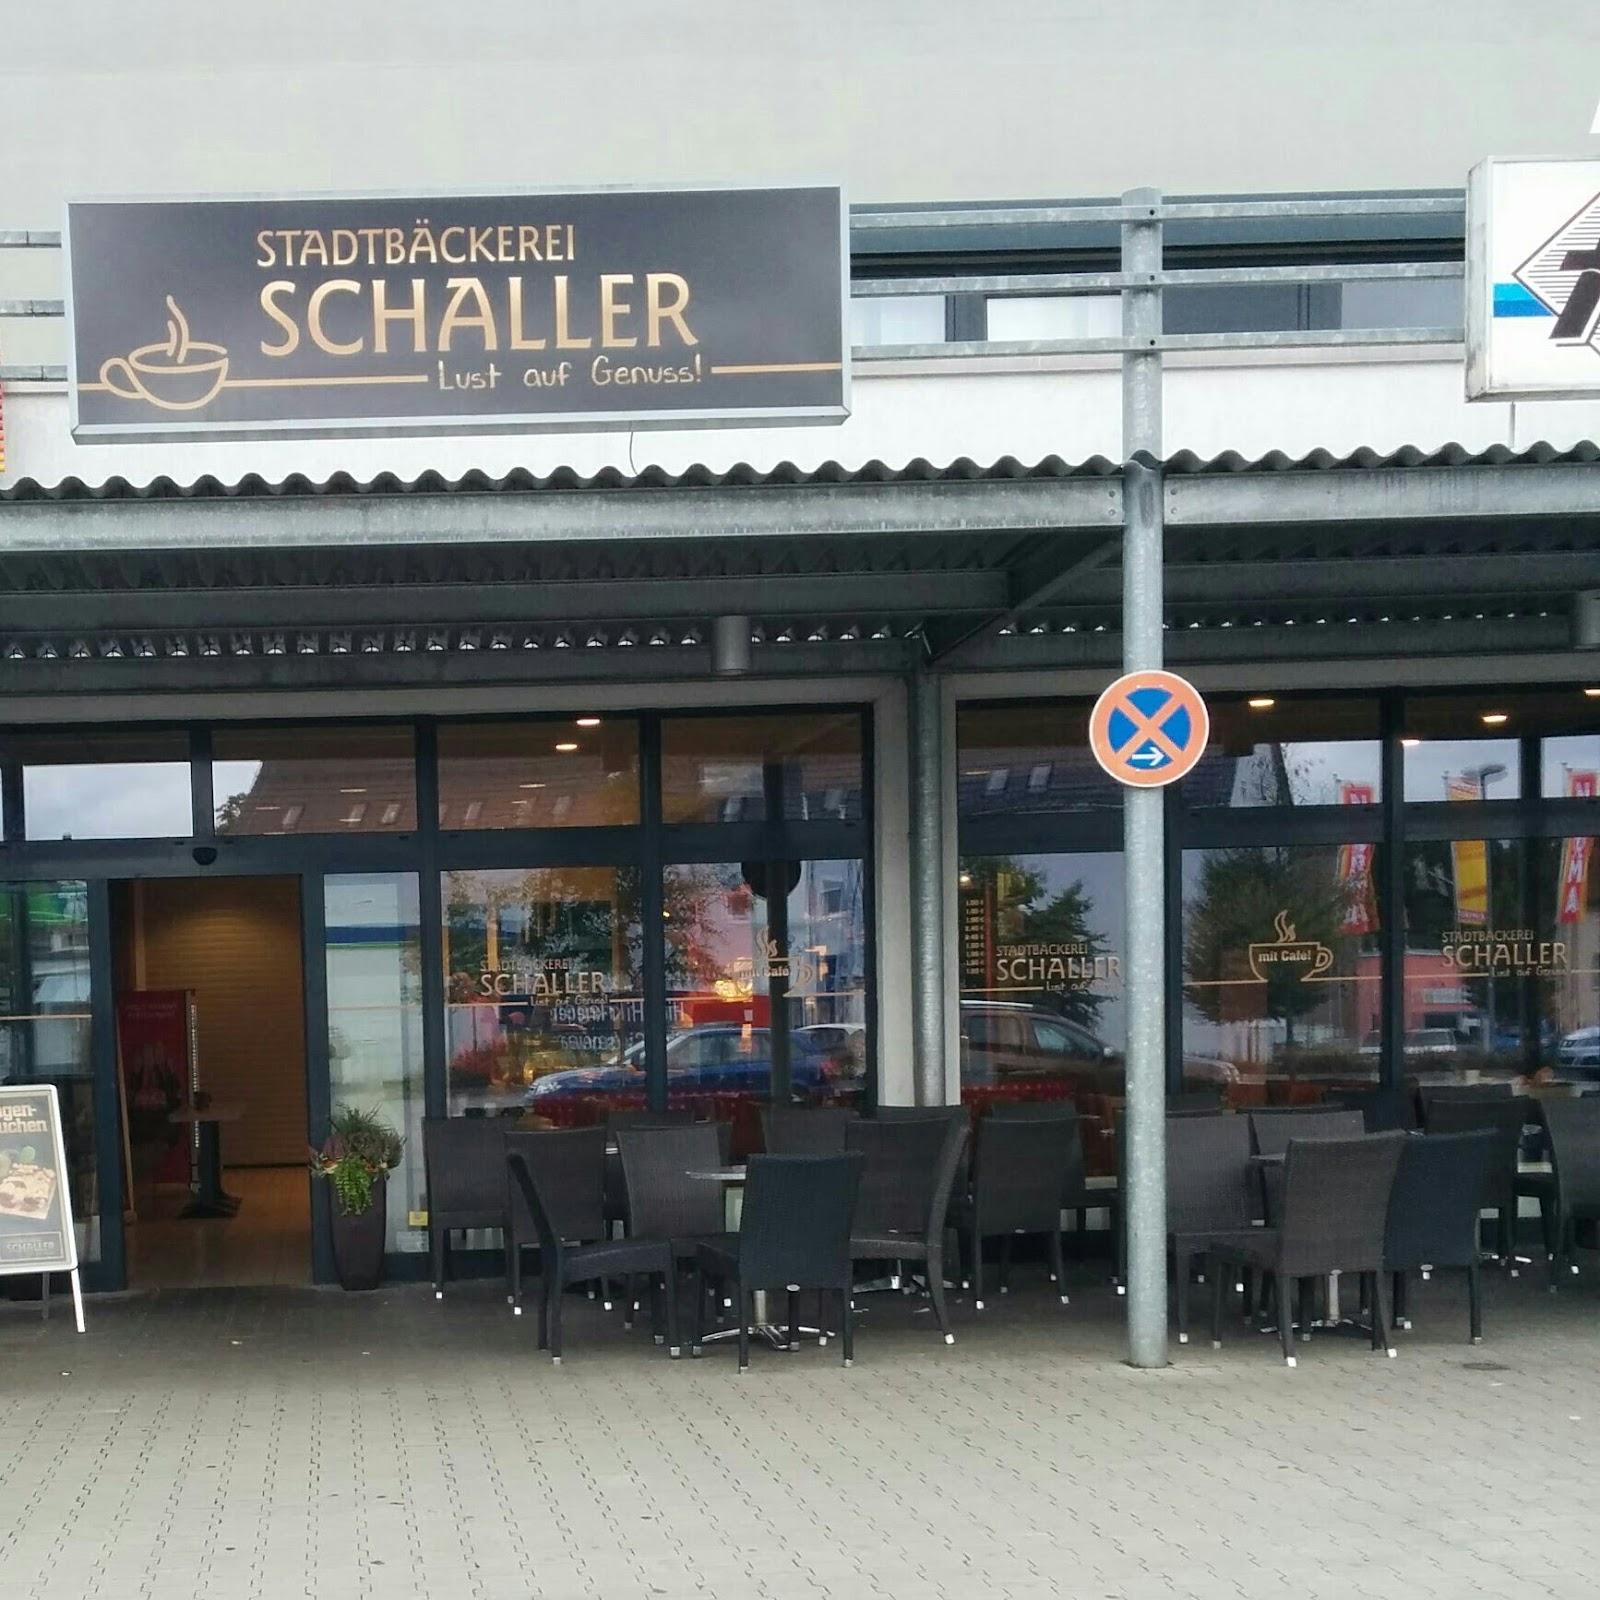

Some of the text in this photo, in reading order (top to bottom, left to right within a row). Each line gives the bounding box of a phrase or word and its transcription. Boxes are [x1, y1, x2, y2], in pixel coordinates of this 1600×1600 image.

[257, 219, 575, 268] STADTBÄCKEREI
[260, 273, 698, 356] SCHALLER
[437, 354, 704, 391] Lust auf Genuss!
[995, 955, 1121, 982] SCHALLER
[1441, 941, 1568, 967] SCHALLER
[480, 971, 607, 997] SCHALLER
